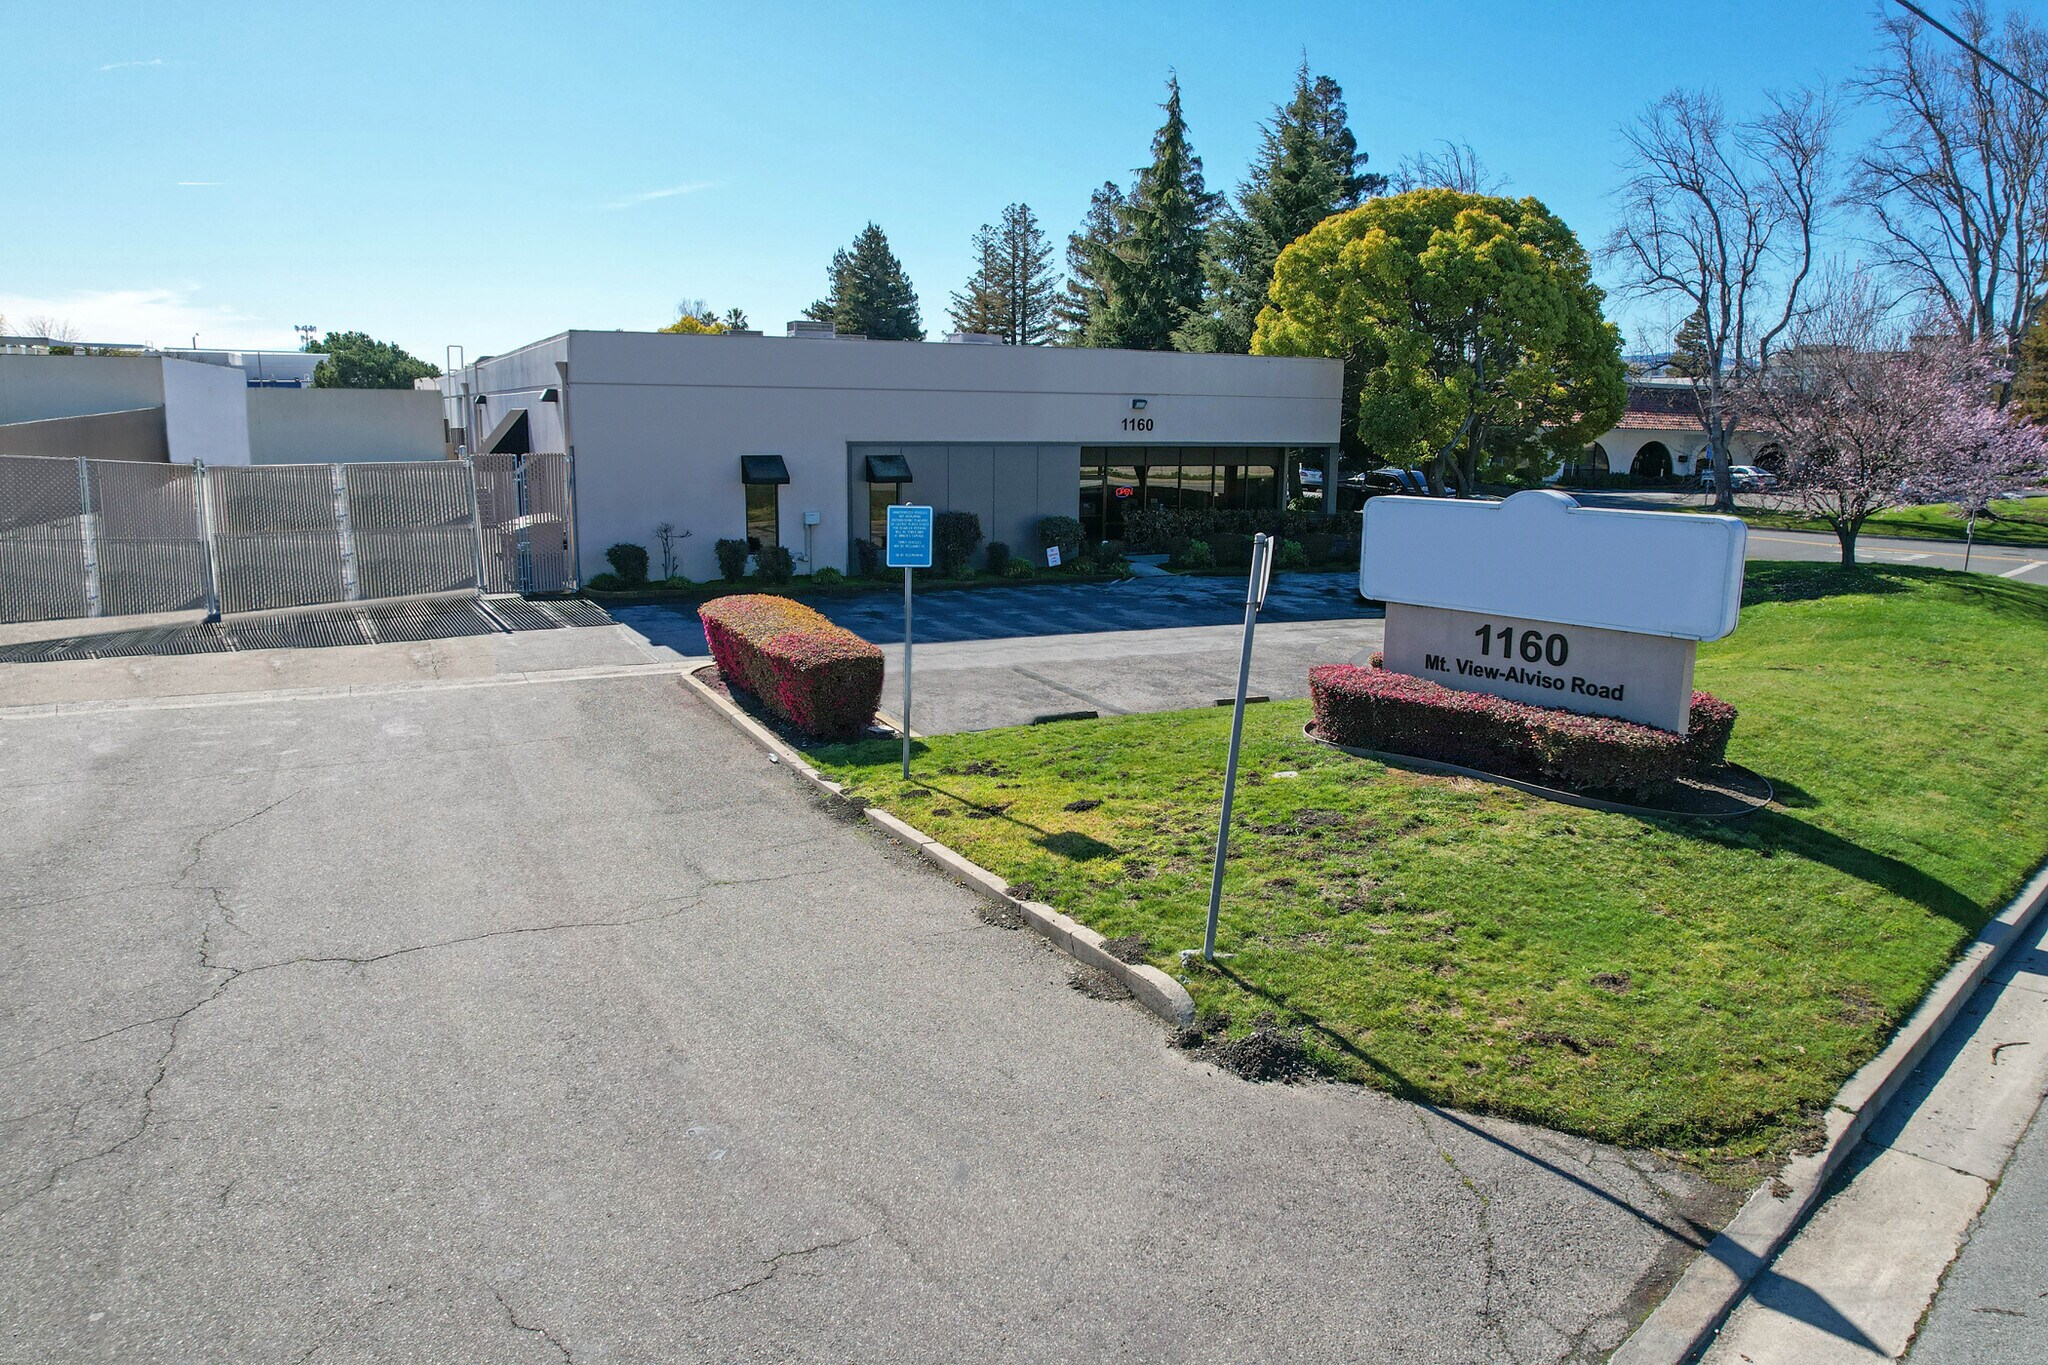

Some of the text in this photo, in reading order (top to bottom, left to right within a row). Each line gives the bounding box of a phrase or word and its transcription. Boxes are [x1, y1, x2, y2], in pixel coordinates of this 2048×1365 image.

[1121, 418, 1153, 431] 1160
[1115, 487, 1133, 497] OPEN
[1475, 624, 1569, 667] 1160
[1425, 653, 1625, 701] Mt. View-Alviso Road
